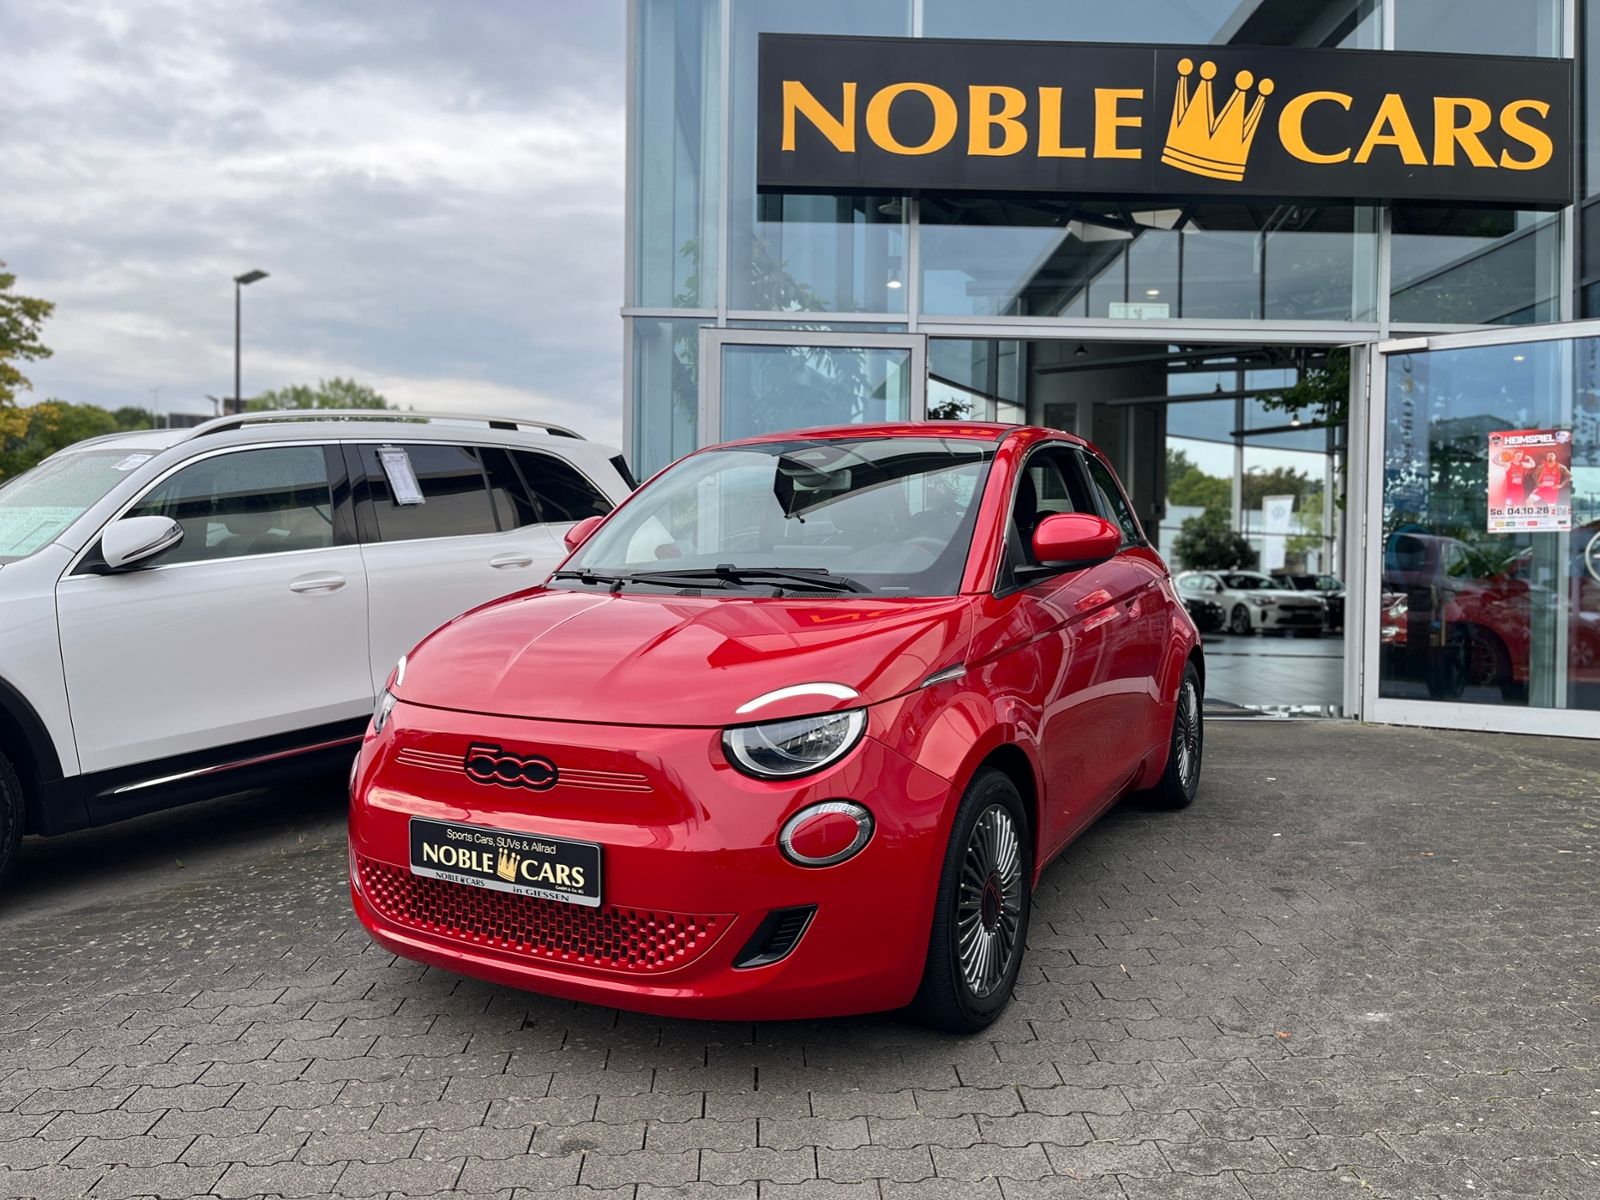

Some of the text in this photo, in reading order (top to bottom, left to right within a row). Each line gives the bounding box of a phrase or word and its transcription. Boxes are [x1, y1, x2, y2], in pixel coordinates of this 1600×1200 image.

[781, 80, 1554, 171] NOBLE CARS
[1504, 434, 1556, 445] HEIMSPIEL
[465, 743, 558, 789] 500
[446, 828, 557, 855] Sports Cars, SUVs & Allrad
[422, 841, 585, 888] NOBLE CARS
[435, 871, 485, 887] NOBLE CARS
[513, 886, 570, 902] in GIESSEN
